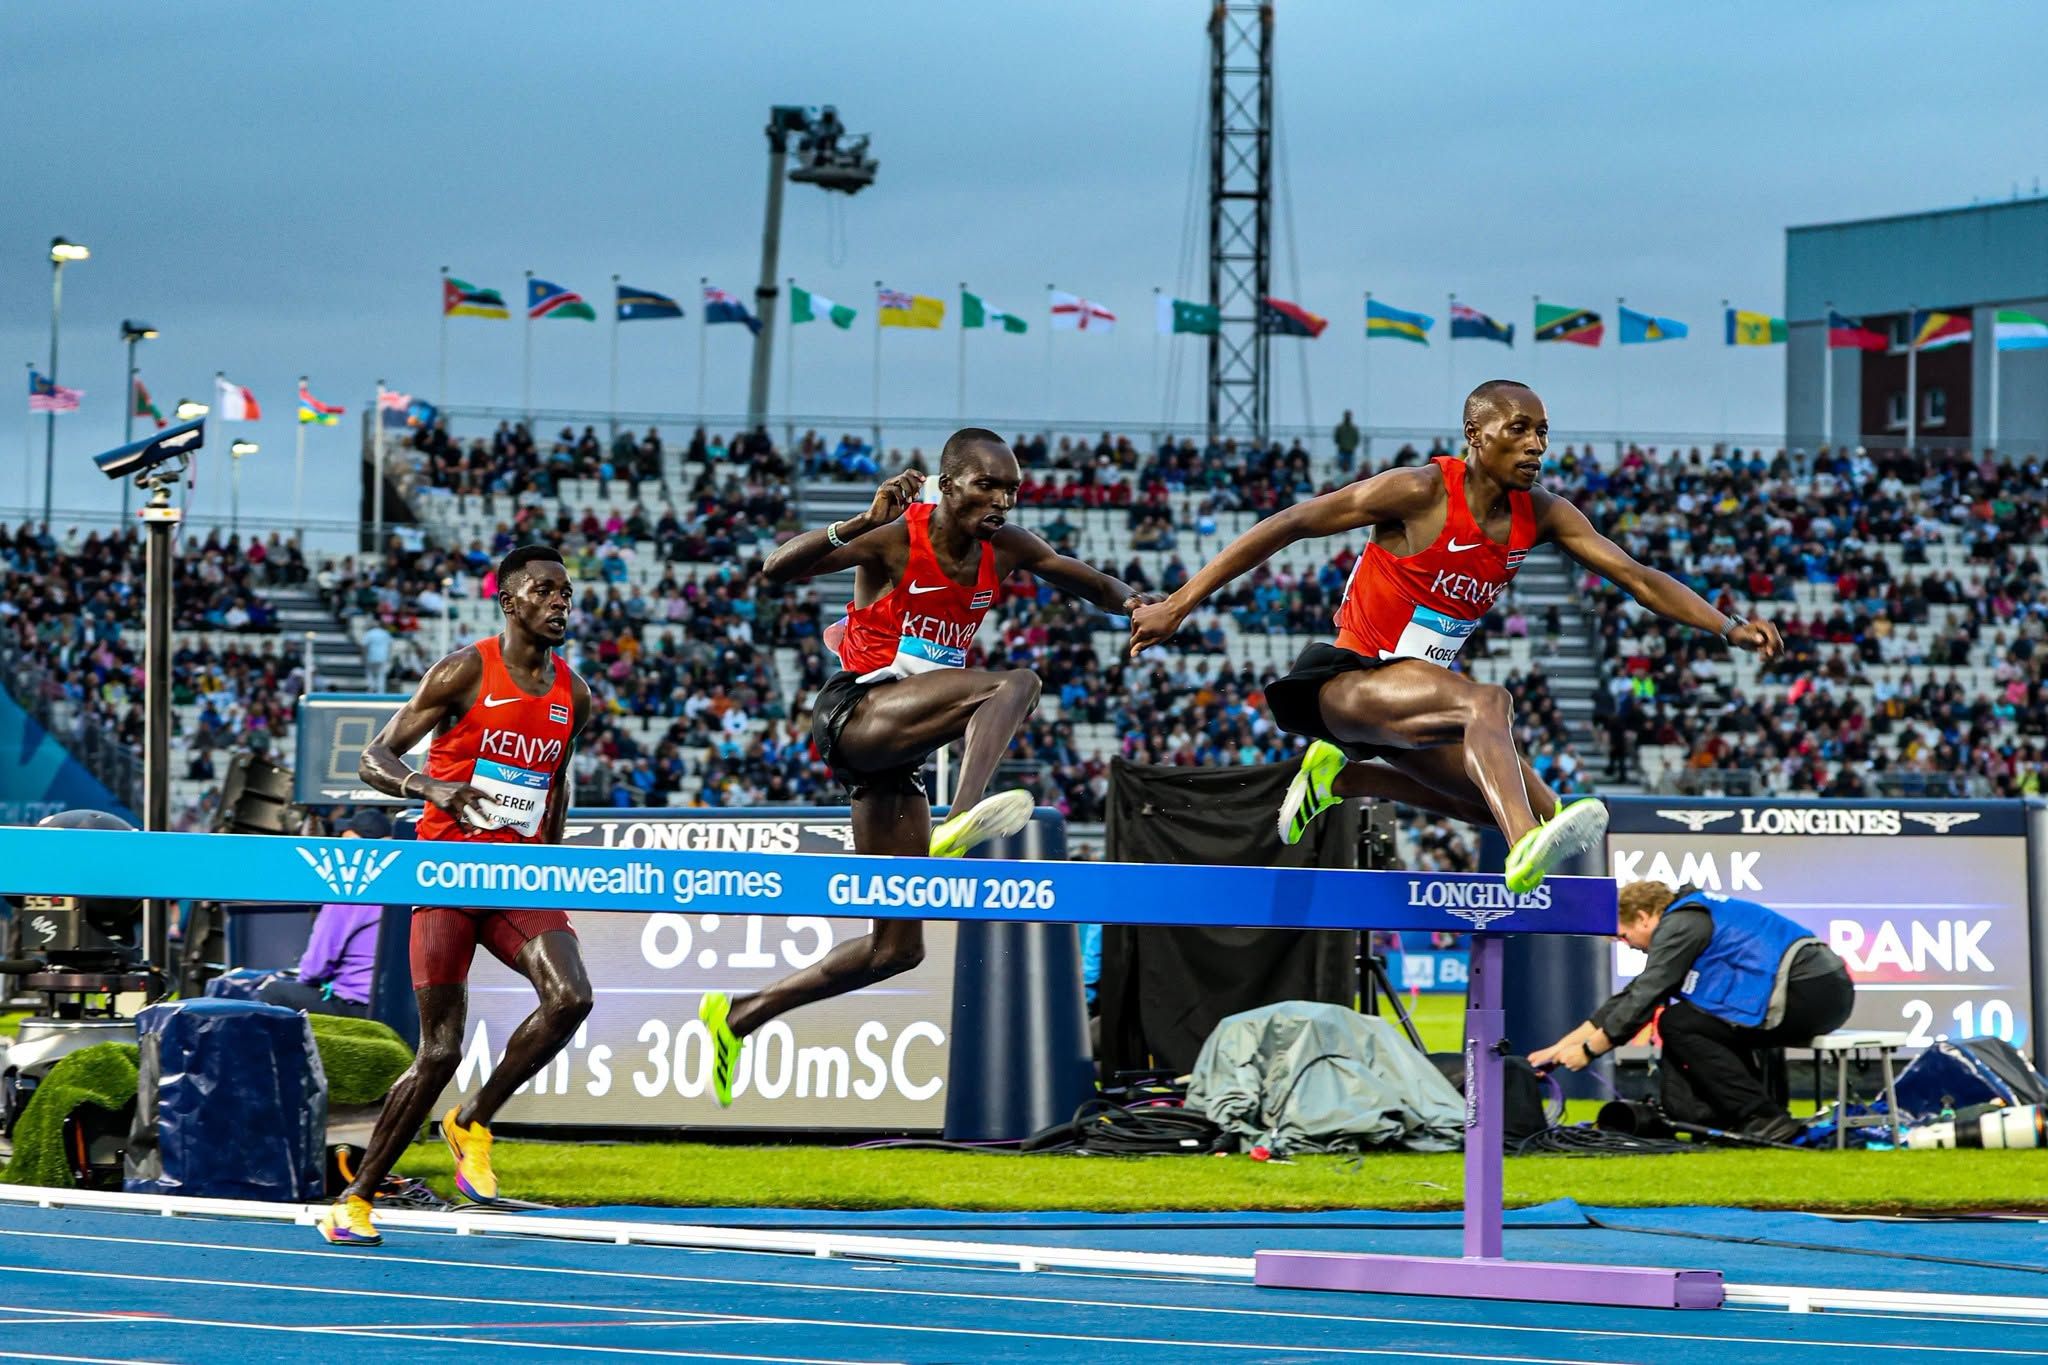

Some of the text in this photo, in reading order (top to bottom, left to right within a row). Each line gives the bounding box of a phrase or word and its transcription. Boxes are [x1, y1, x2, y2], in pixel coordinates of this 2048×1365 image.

[480, 728, 562, 764] KENYA
[494, 793, 535, 812] SEREM
[601, 823, 799, 852] LONGINES
[1740, 808, 1902, 835] LONGINES
[416, 860, 783, 903] commonwealth games
[1614, 850, 1763, 892] KAM K
[828, 873, 1055, 909] GLASGOW 2026
[1408, 881, 1551, 909] LONGINES
[1829, 920, 1994, 972] RANK
[1902, 1000, 2014, 1048] 2.10
